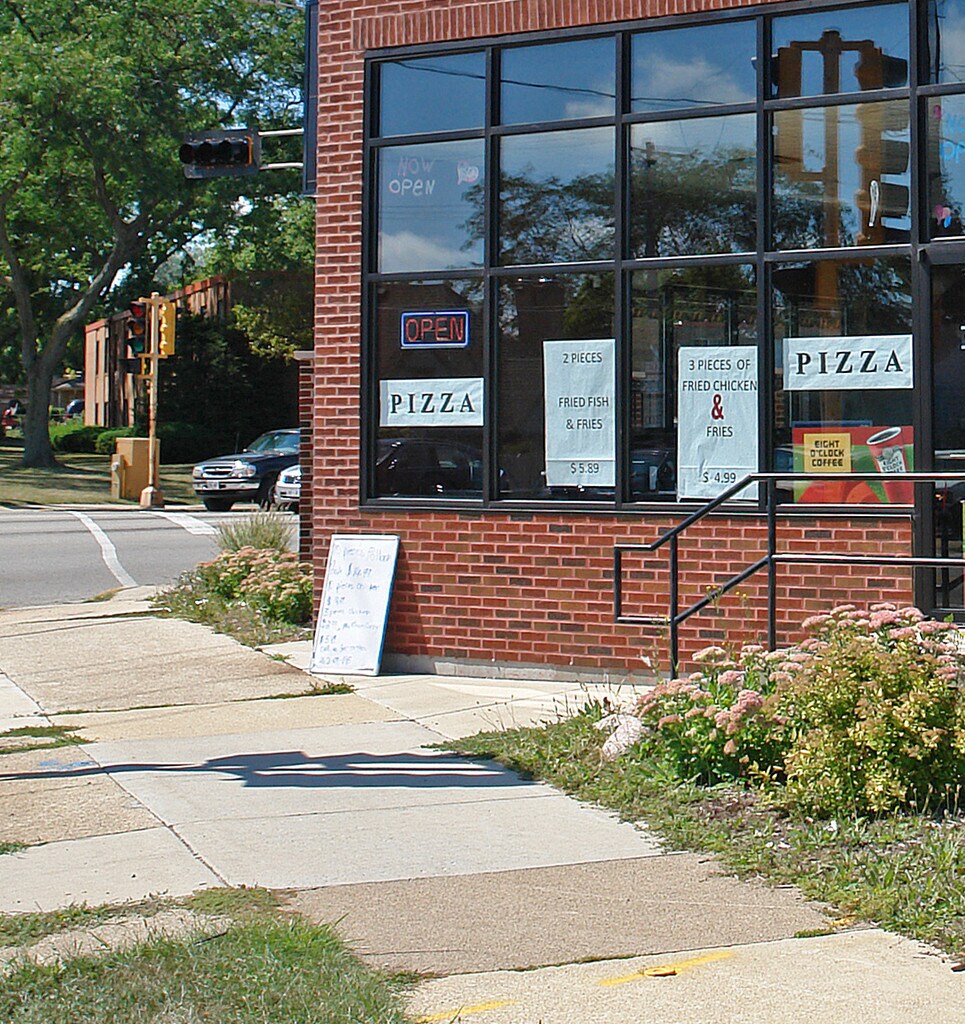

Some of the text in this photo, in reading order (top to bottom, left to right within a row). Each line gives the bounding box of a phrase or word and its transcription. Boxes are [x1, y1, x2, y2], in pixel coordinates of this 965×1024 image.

[398, 156, 435, 177] NOW
[405, 317, 464, 342] OPEN
[562, 352, 603, 364] 2 PIECES
[795, 349, 904, 375] PIZZA
[688, 359, 752, 371] 3 PIECES OF
[682, 380, 758, 392] FRIED CHICKEN
[390, 393, 476, 414] PIZZA
[558, 396, 609, 408] FRIED FISH
[711, 393, 724, 420] &
[566, 418, 603, 430] & FRIES
[706, 426, 733, 437] FRIES
[814, 440, 840, 449] EIGHT
[570, 462, 600, 474] $ 5.89
[811, 458, 843, 467] COFFEE
[702, 471, 737, 484] $ 4.99
